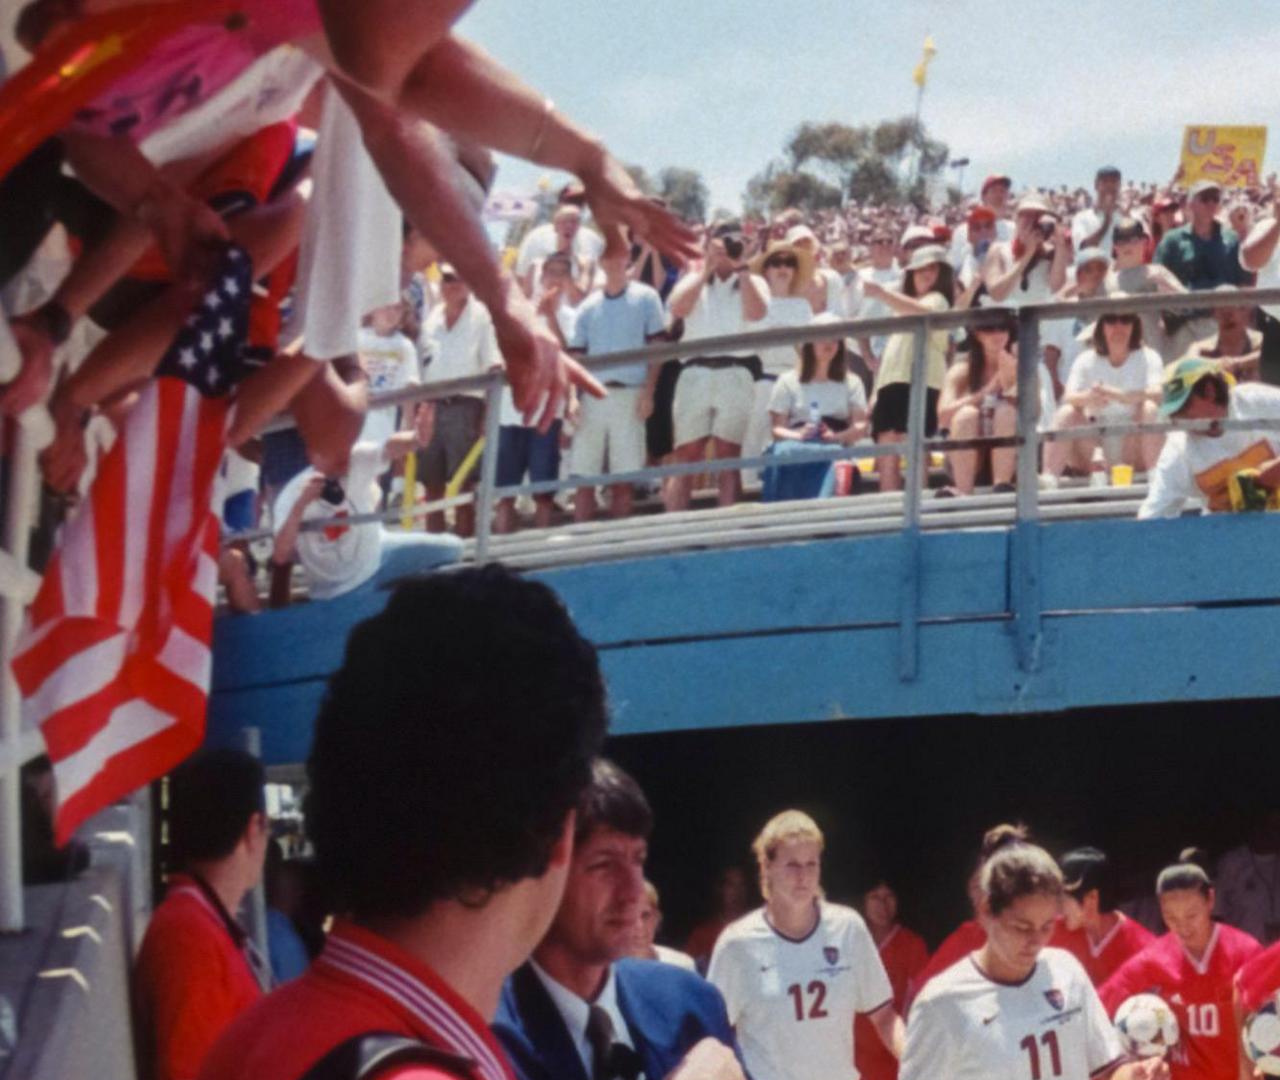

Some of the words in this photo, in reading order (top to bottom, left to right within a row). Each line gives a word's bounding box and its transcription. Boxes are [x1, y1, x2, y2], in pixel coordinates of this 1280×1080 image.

[787, 980, 829, 1021] 12
[1187, 1003, 1220, 1037] 10
[1020, 1030, 1063, 1080] 11
